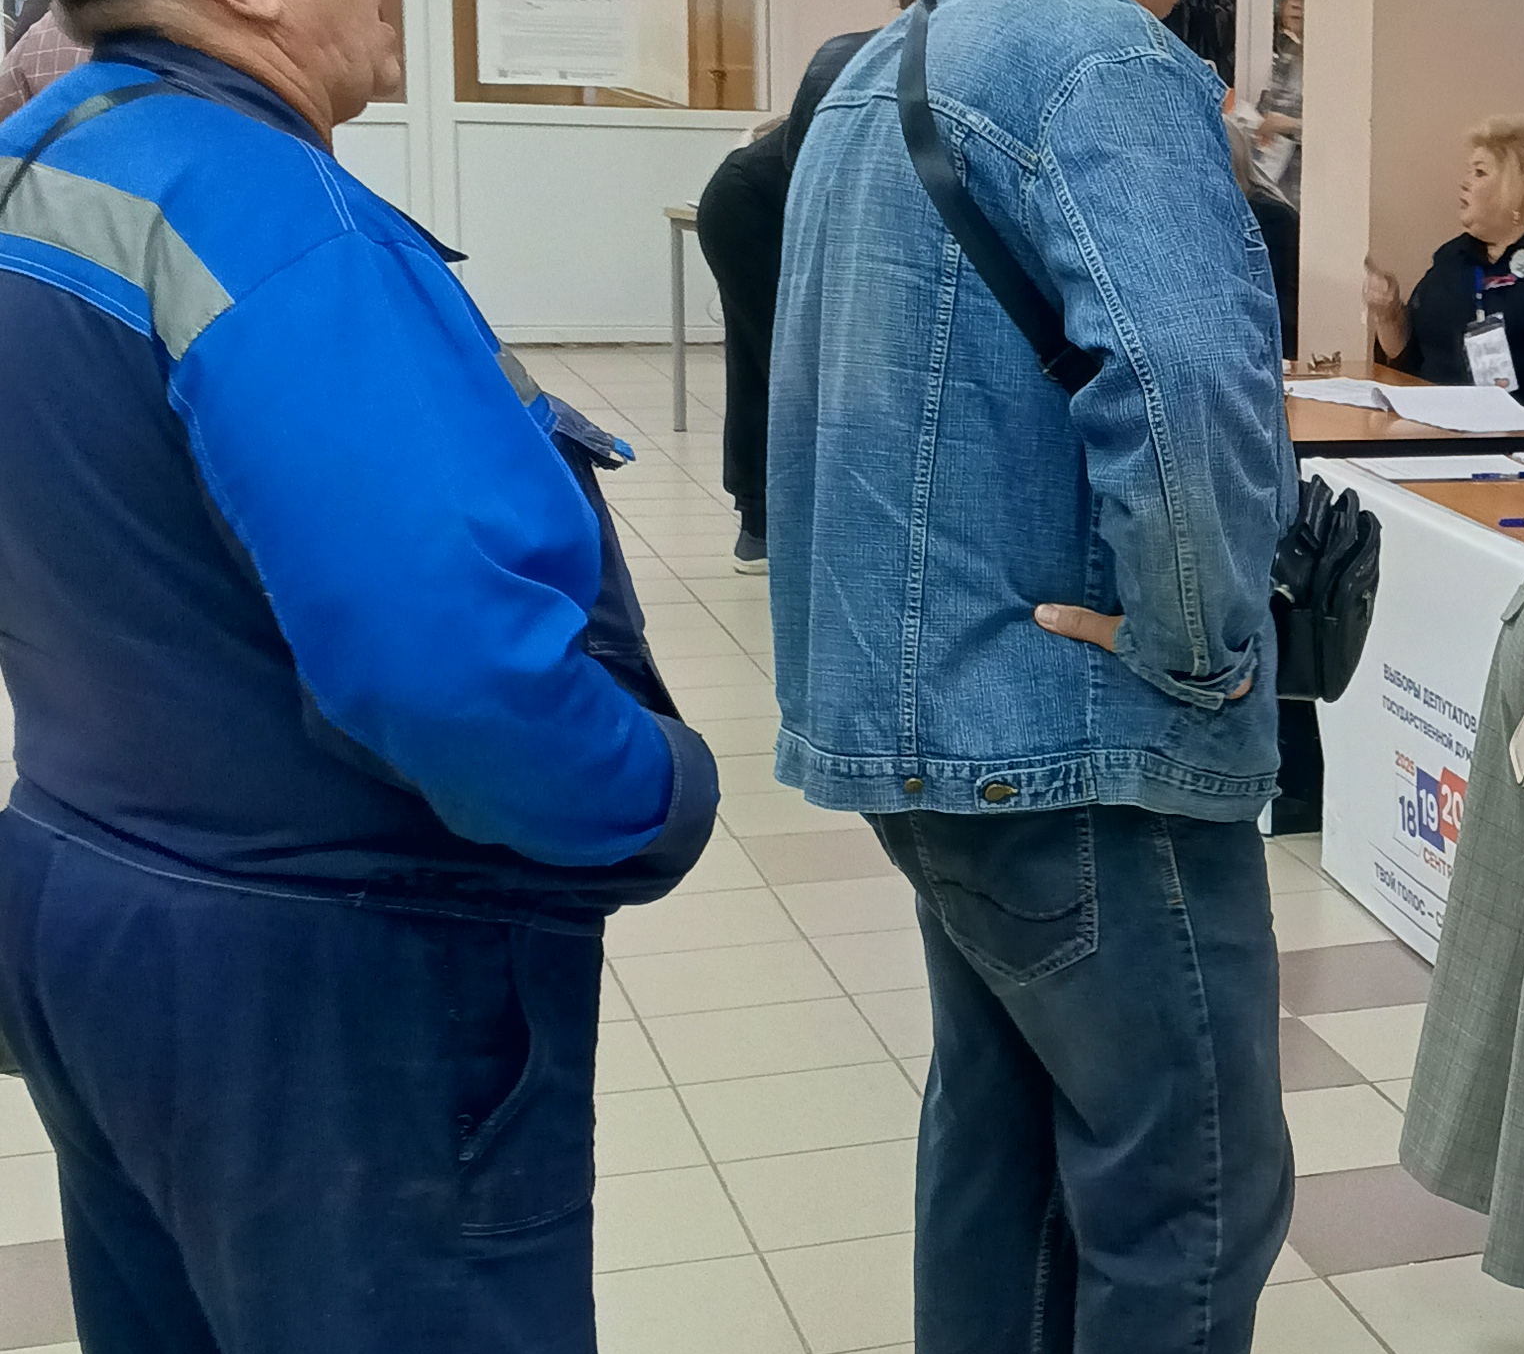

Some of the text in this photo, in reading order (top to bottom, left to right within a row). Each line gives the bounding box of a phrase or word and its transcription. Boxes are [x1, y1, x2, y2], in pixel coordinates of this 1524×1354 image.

[1382, 694, 1454, 752] ГОСУДАРСТВЕННОЙ
[1383, 662, 1477, 734] ВЫБОРЫ ДЕПУТАТОВ
[1398, 784, 1464, 837] 18 19 20
[1374, 861, 1396, 892] ТВОЙ
[1397, 883, 1426, 916] ГОЛОС
